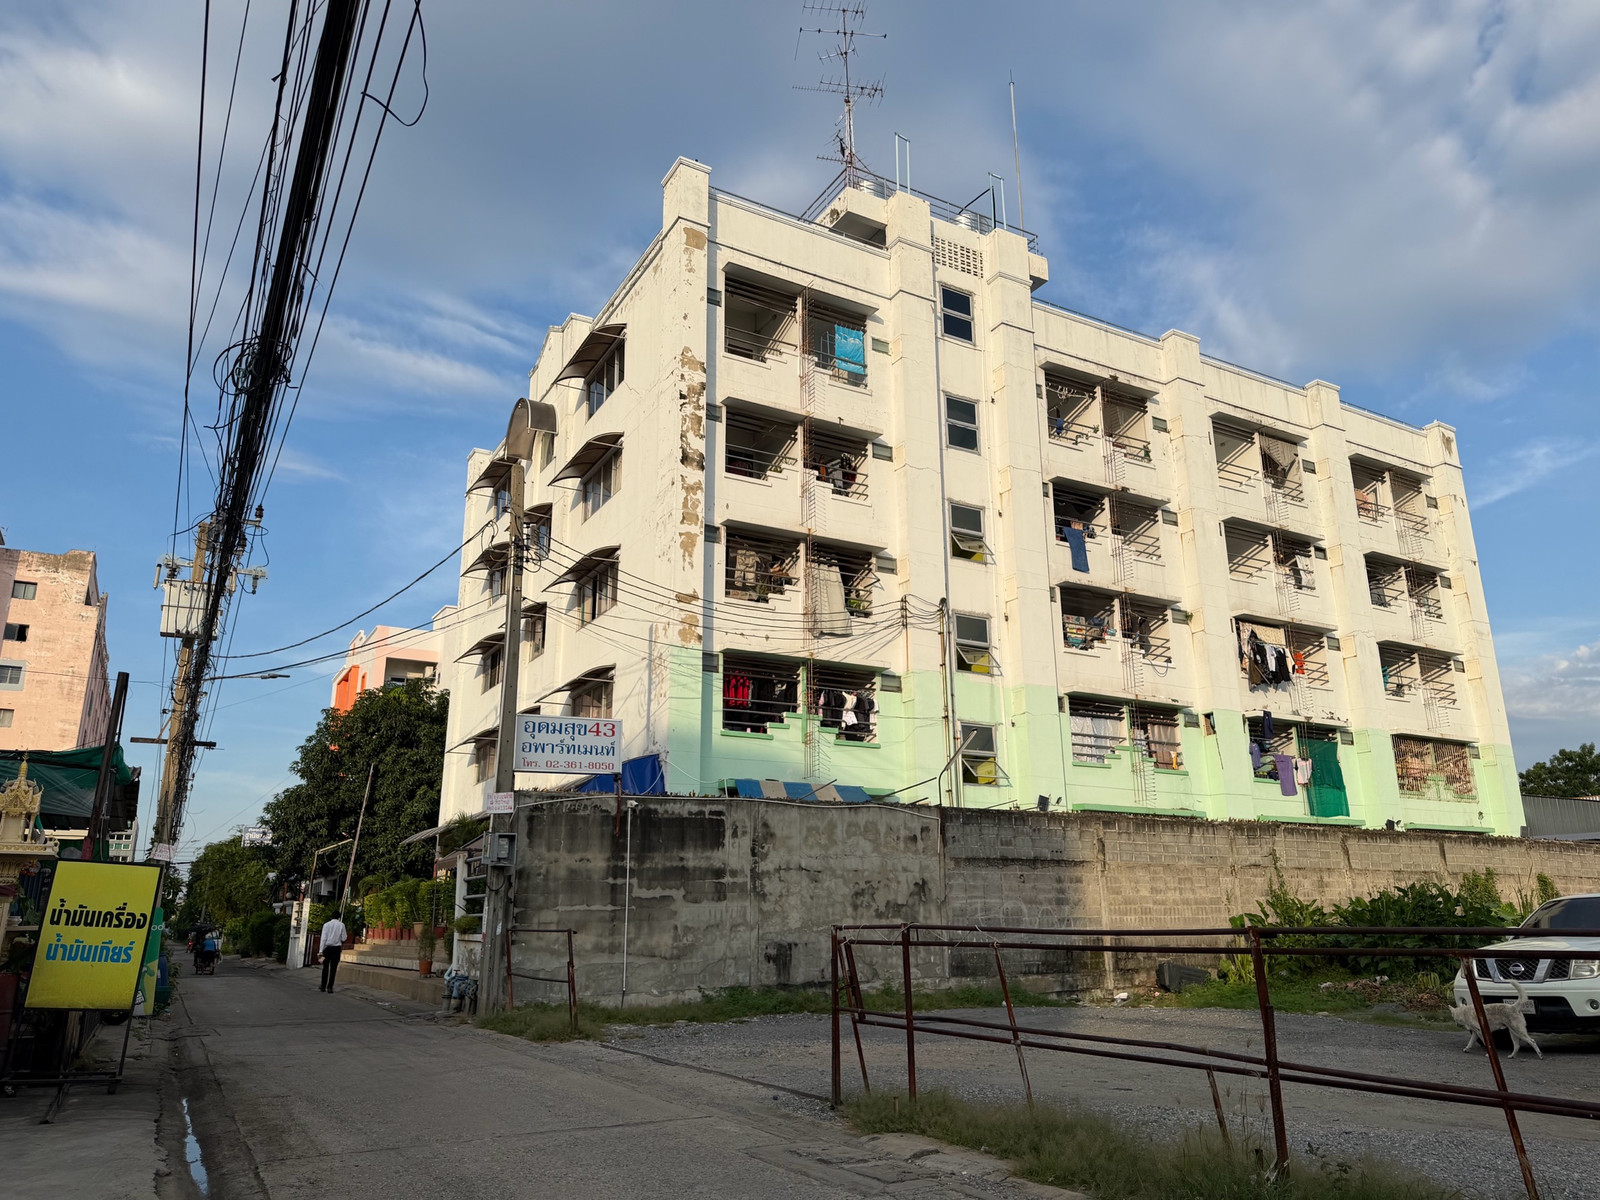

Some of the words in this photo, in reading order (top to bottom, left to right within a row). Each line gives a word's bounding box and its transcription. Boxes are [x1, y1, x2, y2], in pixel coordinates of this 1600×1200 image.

[523, 721, 616, 741] อุดมสุข43
[521, 738, 616, 757] อพาร์ทเมนท์
[522, 757, 541, 768] โทร.
[545, 760, 615, 771] 02-361-8050
[49, 898, 148, 930] น้ำมันเครื่อง
[45, 933, 136, 963] น้ำมันเกียร์
